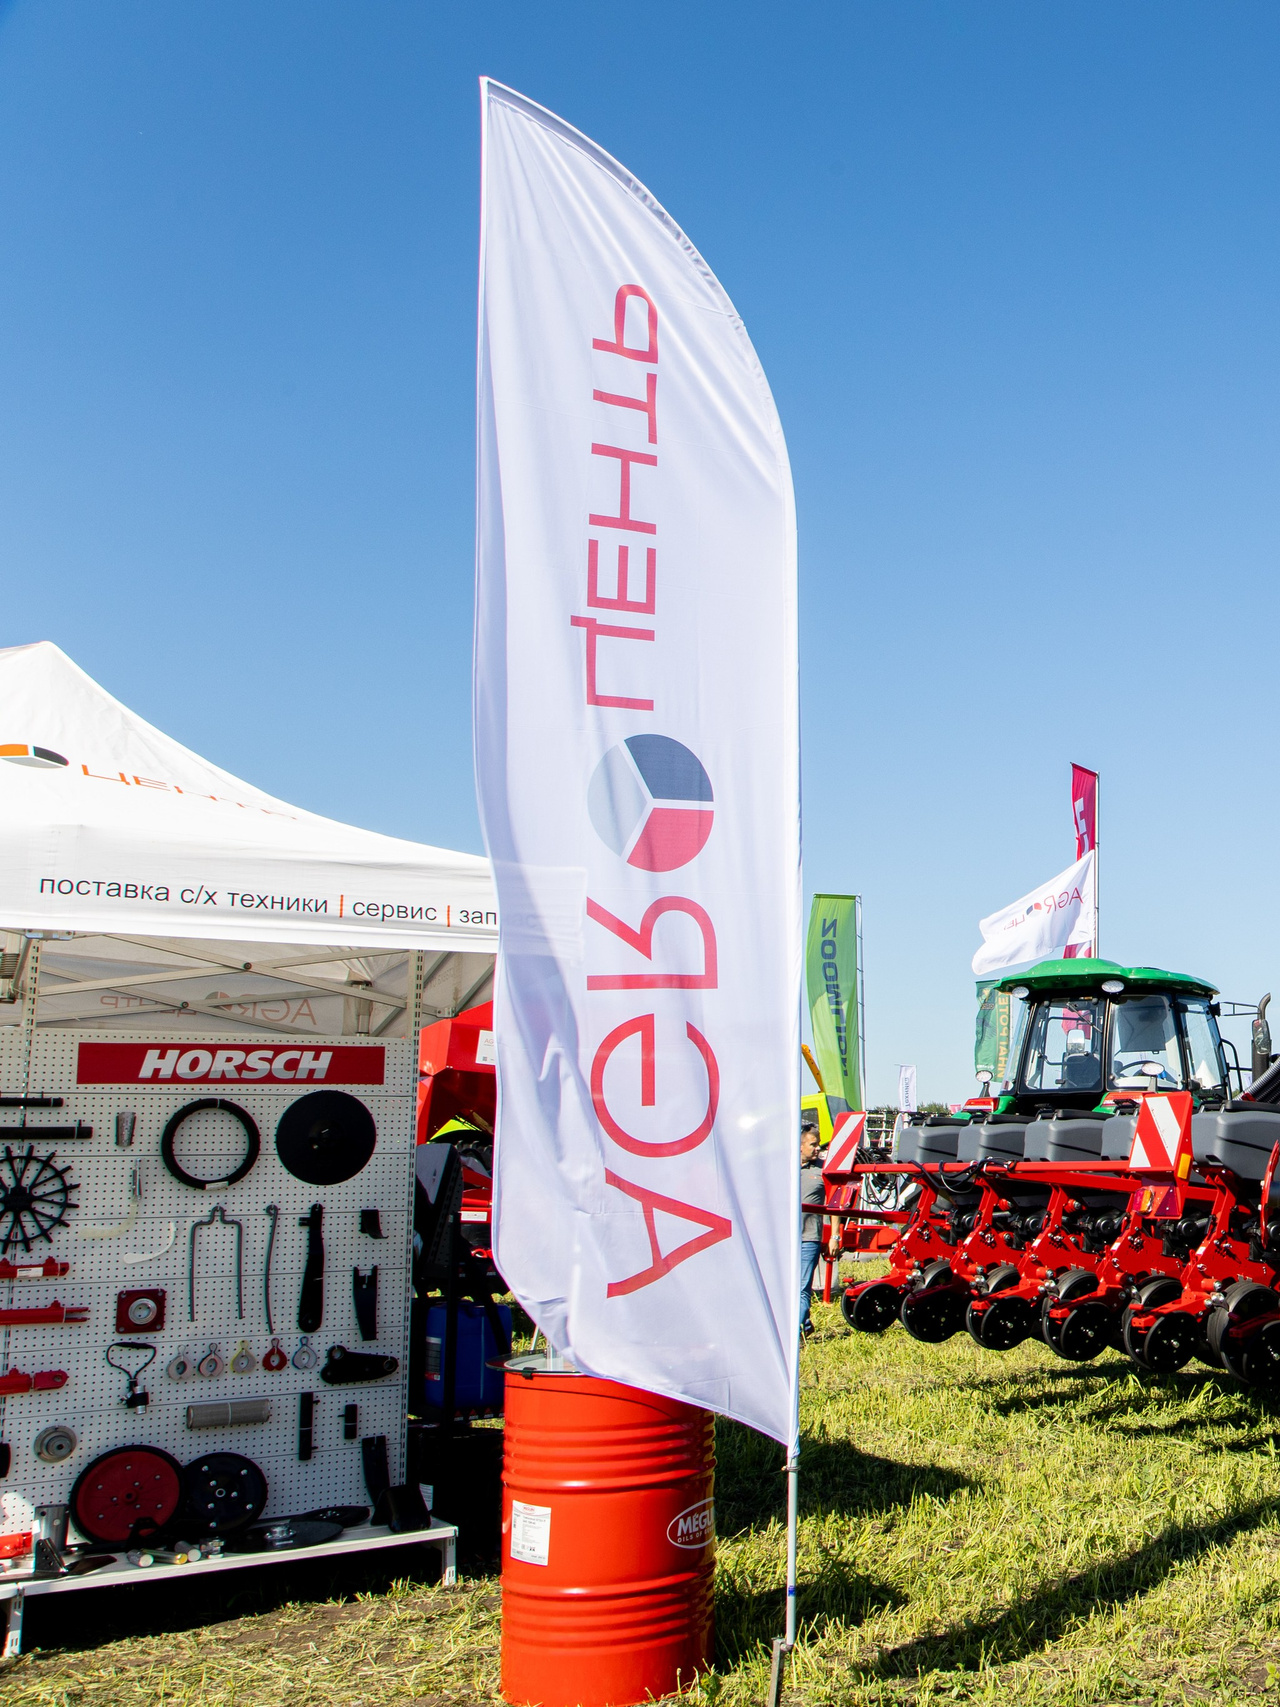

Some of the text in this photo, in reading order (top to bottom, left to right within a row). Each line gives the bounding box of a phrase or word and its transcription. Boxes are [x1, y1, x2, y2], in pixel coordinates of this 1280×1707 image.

[39, 876, 497, 925] поставка с/х техники сервис зап
[138, 1049, 333, 1079] HORSCH
[677, 1506, 715, 1536] MÉGU
[677, 1535, 693, 1543] OILS
